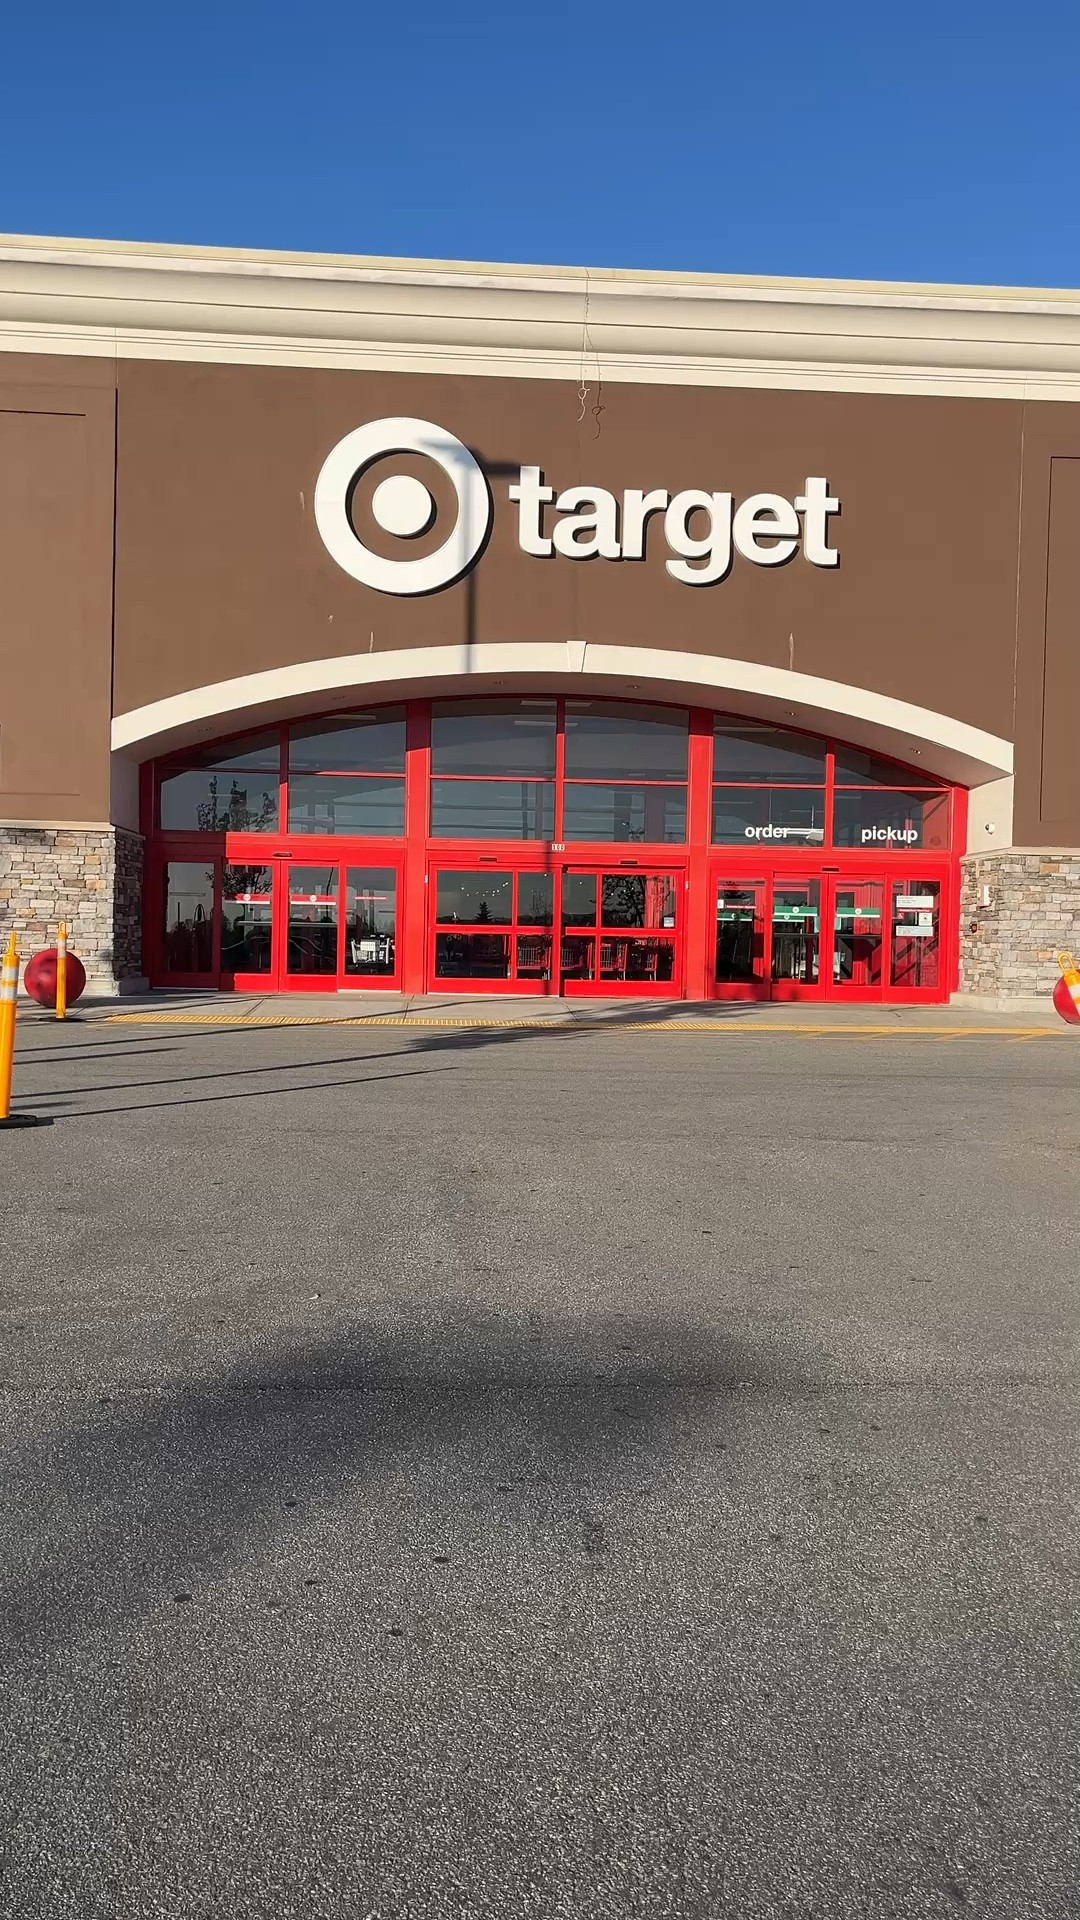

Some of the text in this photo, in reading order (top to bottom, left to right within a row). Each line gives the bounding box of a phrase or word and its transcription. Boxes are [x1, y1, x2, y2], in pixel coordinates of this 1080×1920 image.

[508, 465, 841, 586] target
[744, 824, 918, 843] order pickup
